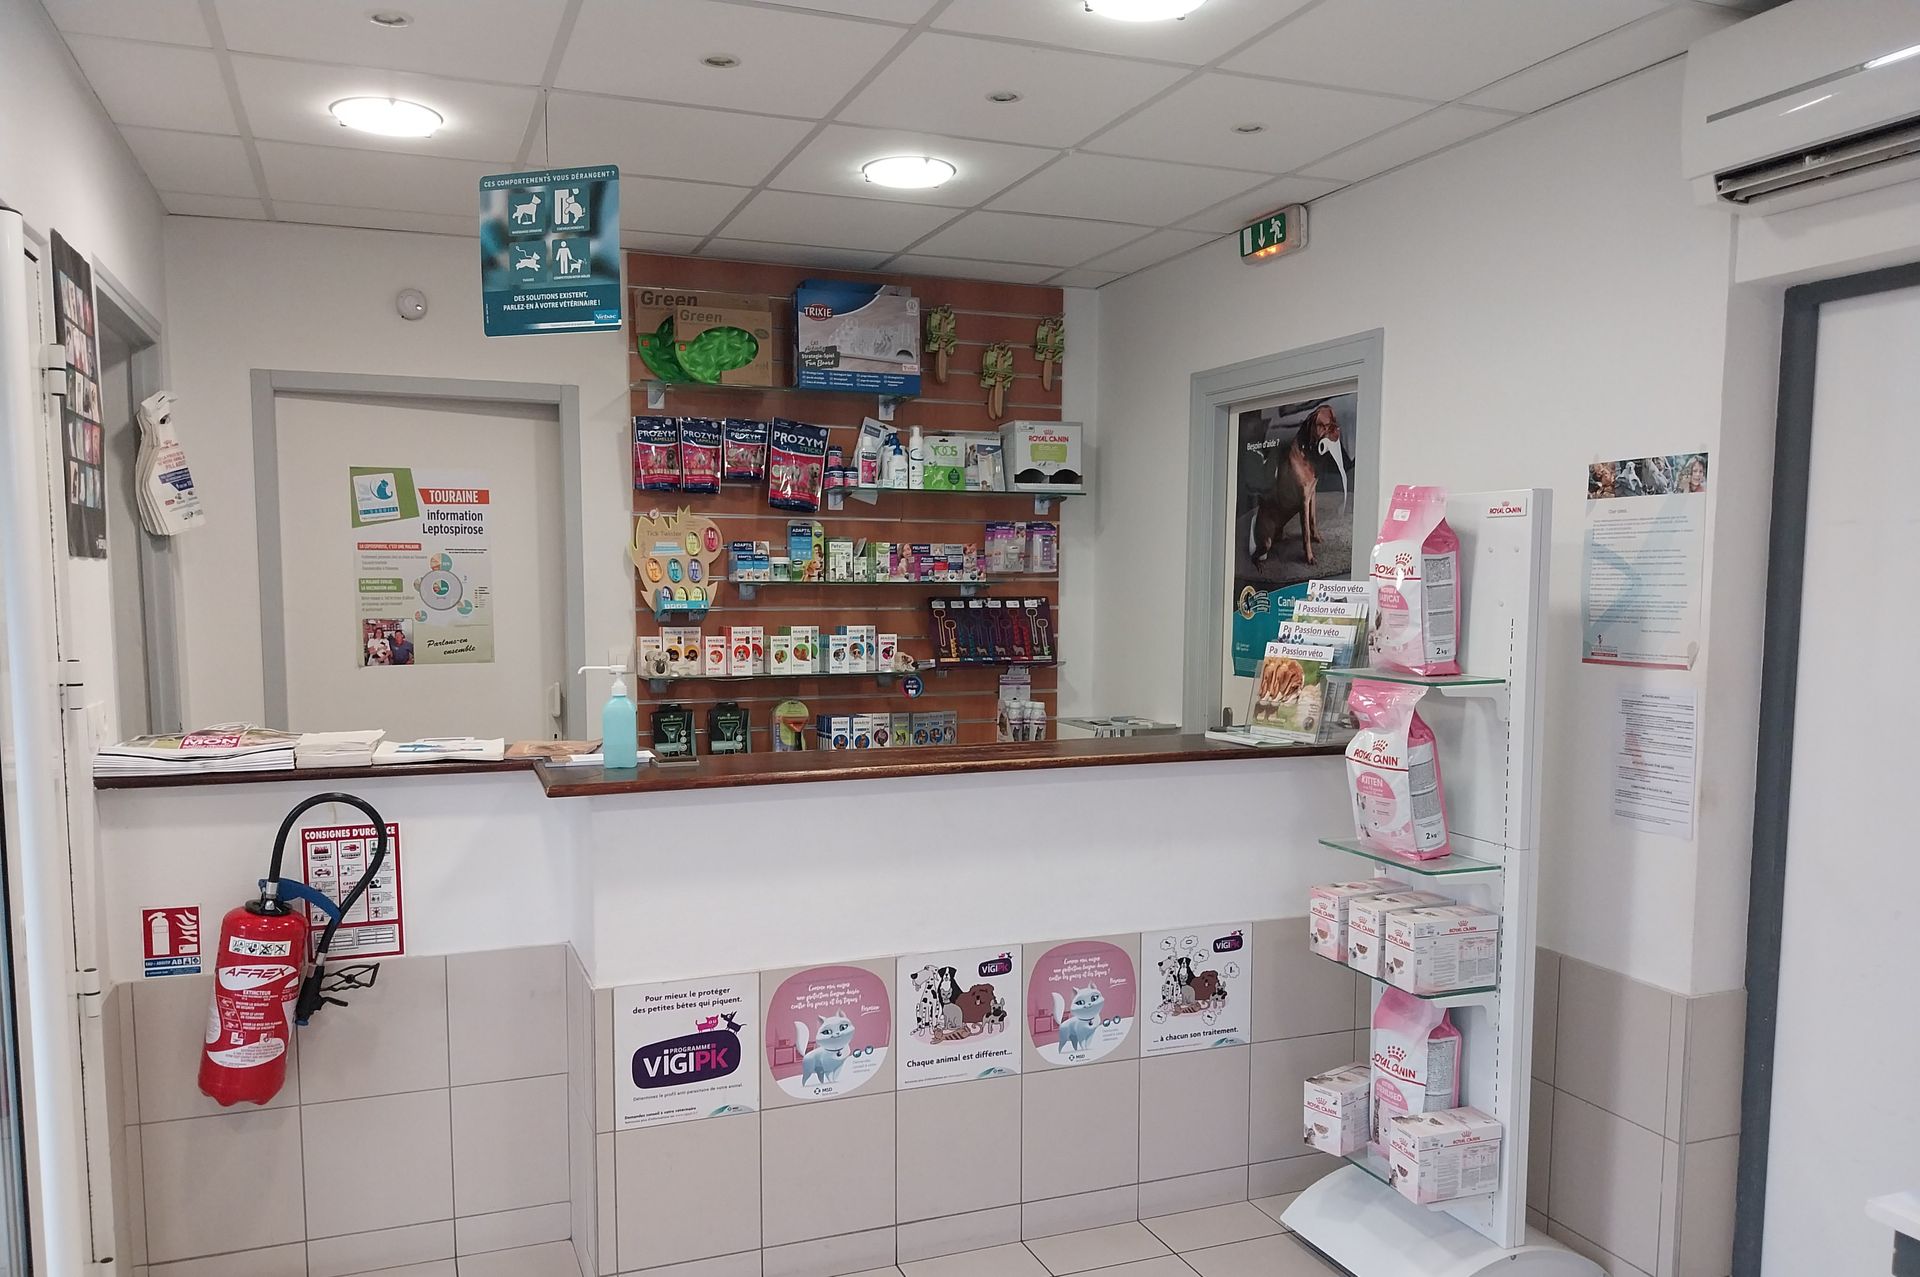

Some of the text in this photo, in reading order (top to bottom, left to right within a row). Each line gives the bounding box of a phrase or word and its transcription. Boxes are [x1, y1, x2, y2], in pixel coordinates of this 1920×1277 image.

[497, 176, 551, 186] COMPORTEMENTS
[571, 171, 610, 180] DÉRANGENT
[559, 291, 588, 299] EXISTENT,
[641, 291, 698, 306] Green
[503, 303, 534, 311] PARLEZ-EN
[535, 301, 539, 309] À
[560, 299, 597, 308] VÉTÉRINAIRE
[680, 310, 722, 323] Green
[804, 307, 832, 317] TRIXIE
[683, 430, 719, 440] PROZYM
[774, 431, 824, 448] PROZYM
[1246, 441, 1262, 451] Besoin
[1263, 439, 1276, 450] d'aide
[429, 490, 478, 503] TOURAINE
[427, 510, 483, 521] information
[423, 524, 483, 536] Leptospirose
[1375, 564, 1394, 576] ROYAL
[1319, 583, 1363, 593] Passion véto
[1302, 605, 1345, 614] Passion véto
[1294, 625, 1340, 636] Passion véto
[427, 638, 468, 648] Parlons-en
[444, 646, 475, 655] ensemble
[1282, 646, 1323, 657] Passion véto
[1354, 749, 1398, 767] ROYAL CANIN
[1361, 775, 1383, 788] KITTEN
[305, 826, 395, 840] CONSIGNES D'URGCE
[1322, 910, 1335, 919] CANIN
[1351, 920, 1375, 934] ROYAL CANIN
[1388, 934, 1410, 948] ROYAL CANIN
[698, 987, 730, 998] protéger
[648, 1004, 674, 1014] petites
[698, 1000, 710, 1008] qui
[712, 996, 742, 1006] piquent.
[1203, 1027, 1238, 1037] traitement.
[670, 1044, 711, 1054] PROGRAMME
[907, 1059, 934, 1068] Chaque
[936, 1054, 960, 1064] animal
[1392, 1063, 1416, 1079] CANIN
[1307, 1101, 1337, 1115] ROYAL CANIN
[1392, 1140, 1415, 1159] ROYAL CANIN
